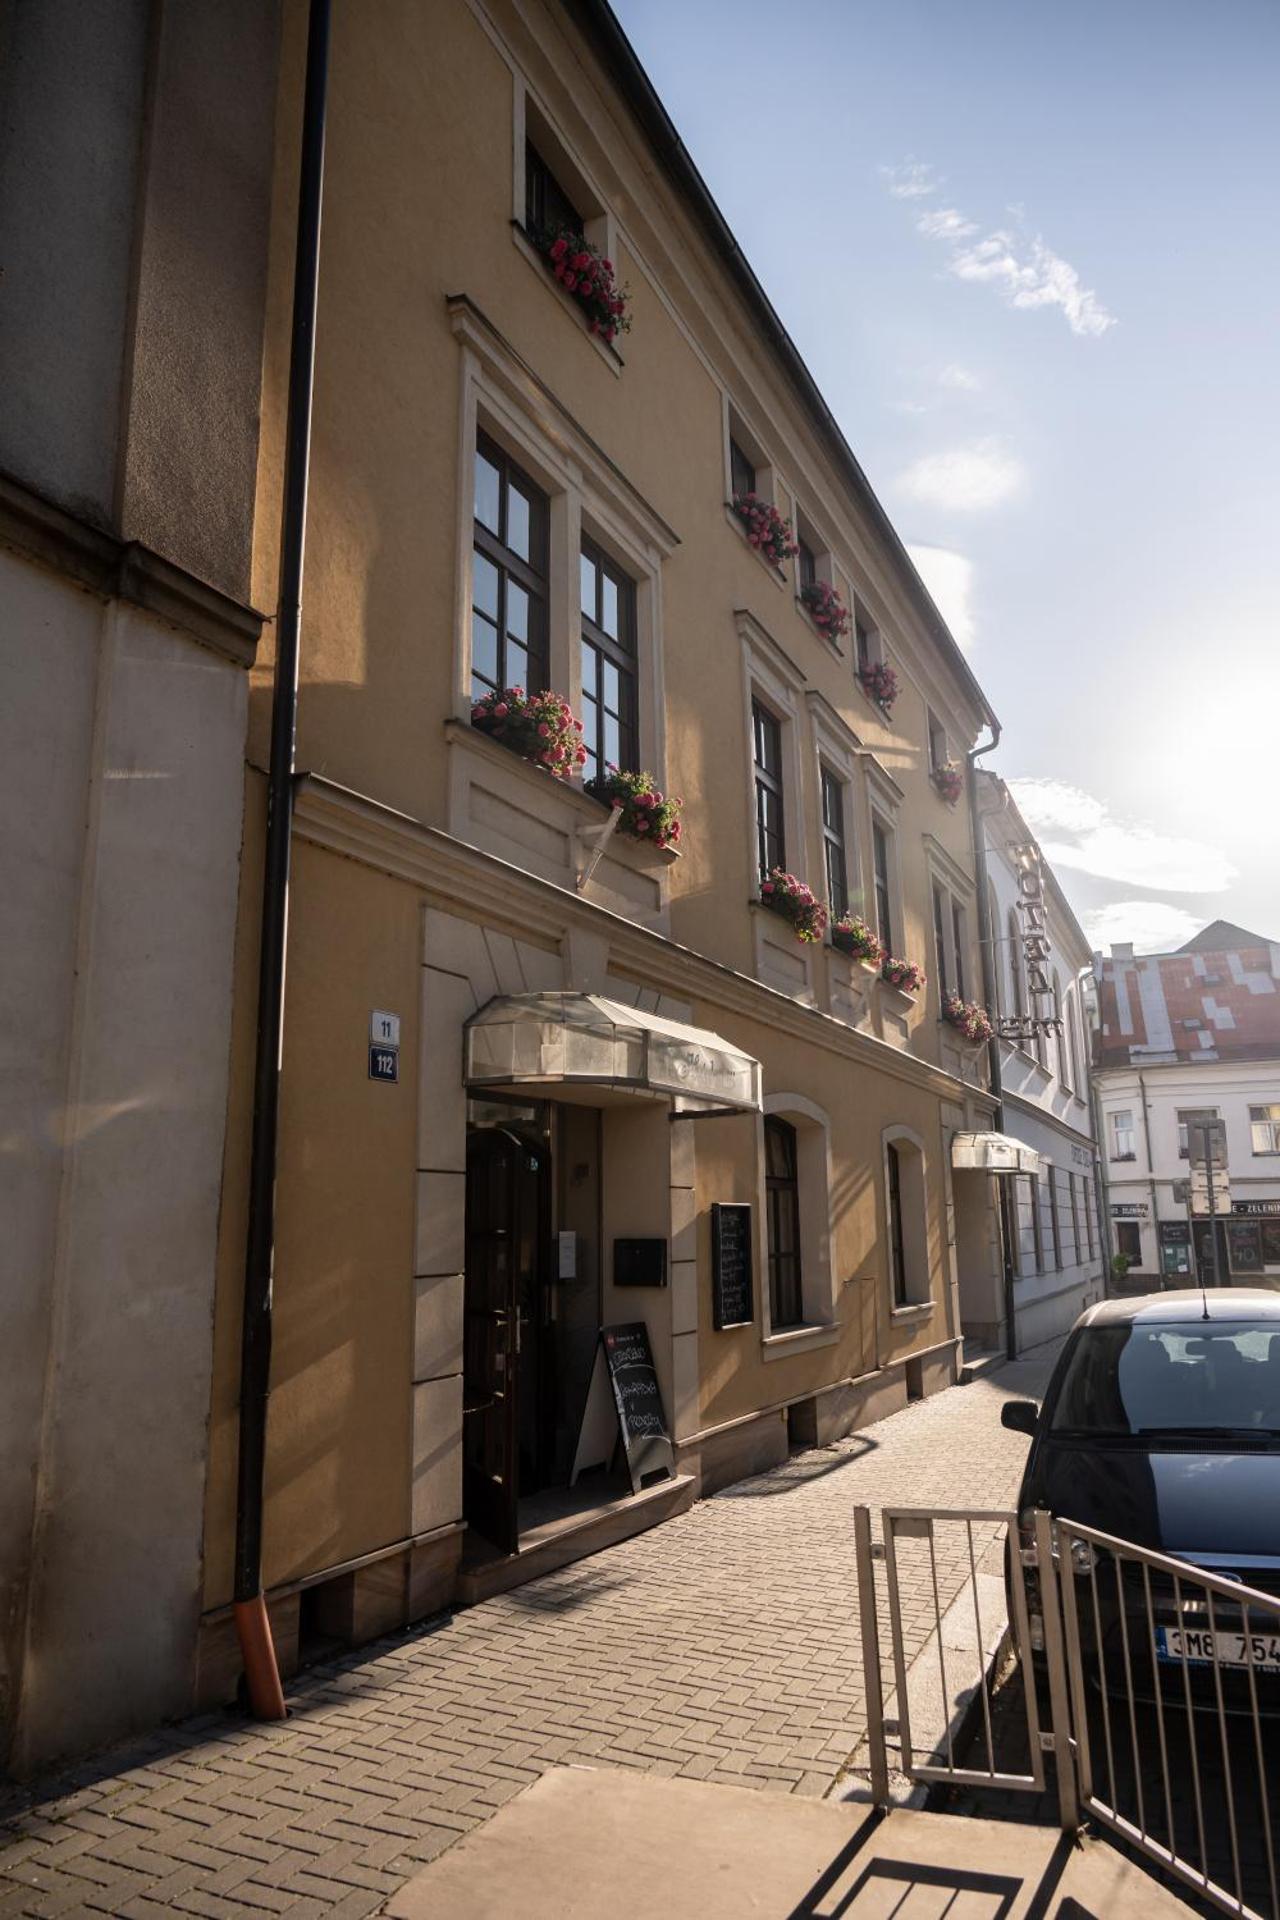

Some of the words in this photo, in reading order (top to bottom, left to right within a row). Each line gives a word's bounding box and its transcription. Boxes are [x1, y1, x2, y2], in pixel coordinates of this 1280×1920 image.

[381, 1020, 391, 1037] 11
[377, 1055, 393, 1073] 112
[1172, 1632, 1215, 1657] 3M8
